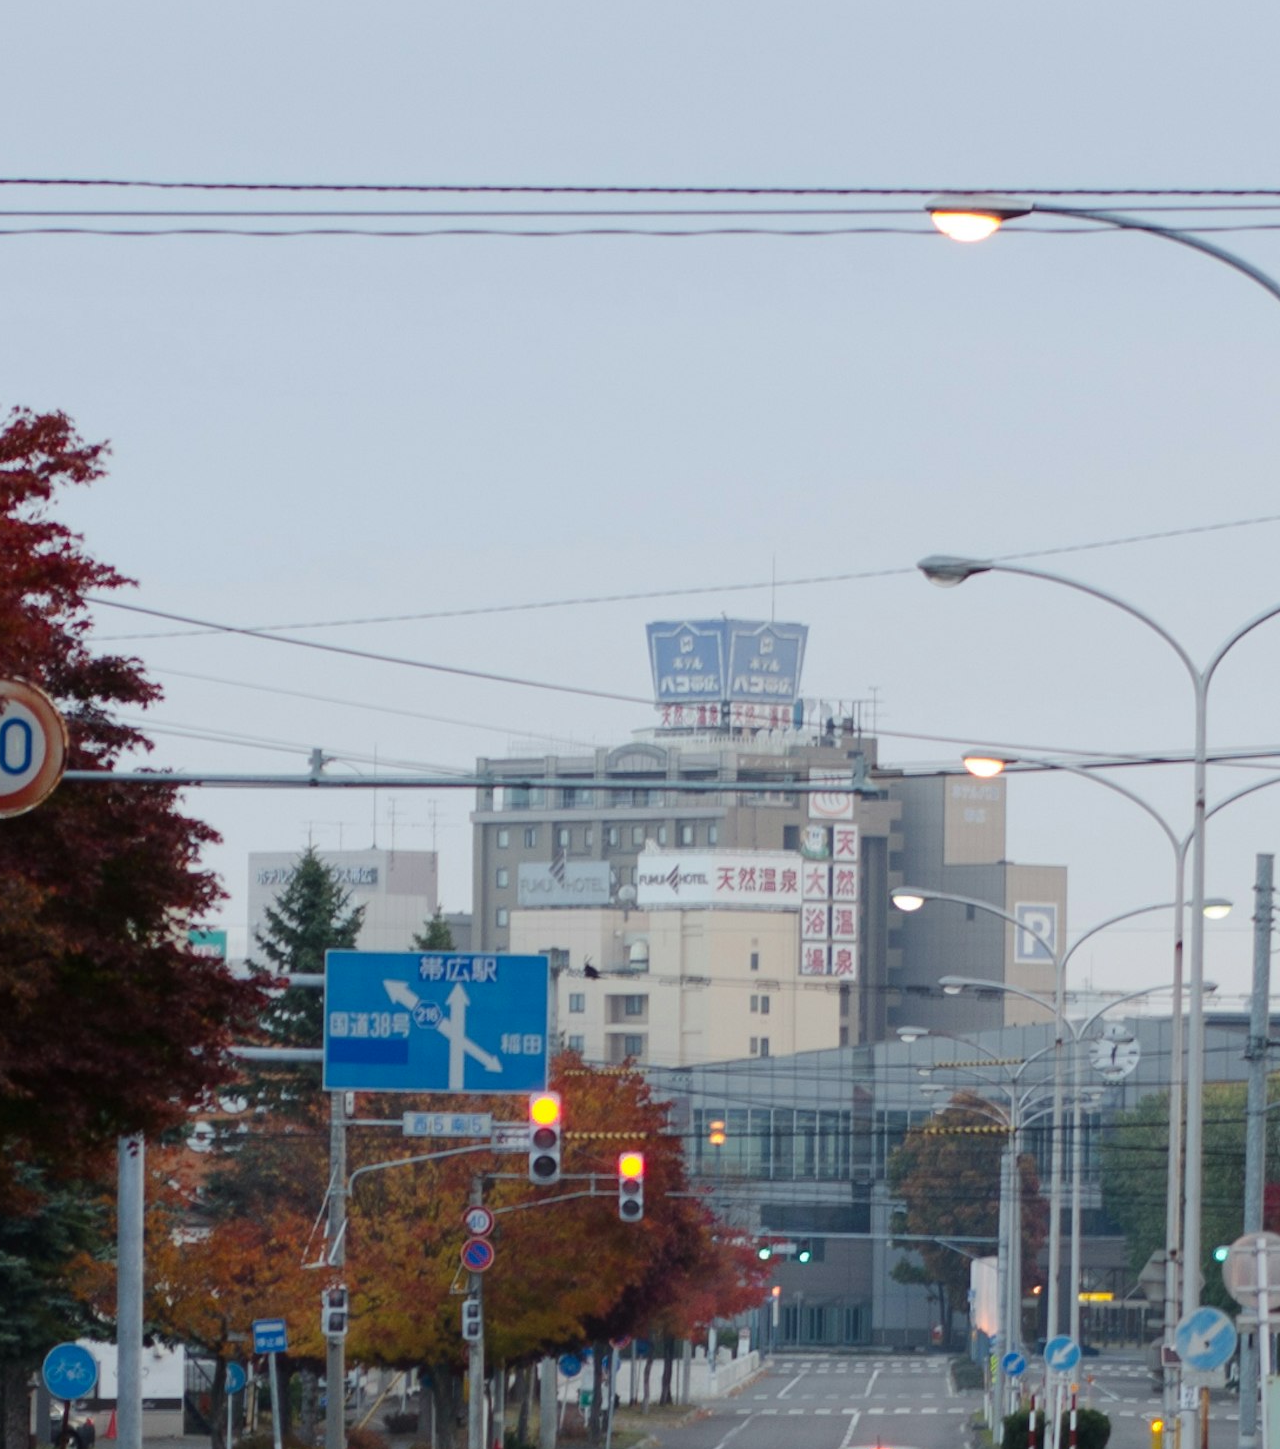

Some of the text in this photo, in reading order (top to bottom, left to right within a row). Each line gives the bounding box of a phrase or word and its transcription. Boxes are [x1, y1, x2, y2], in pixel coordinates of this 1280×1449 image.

[679, 873, 709, 886] HOTEL
[716, 866, 798, 894] 天然温泉
[1023, 912, 1051, 955] P
[420, 956, 498, 983] 帯広駅
[329, 1011, 411, 1038] 国道38号
[500, 1033, 542, 1055] 稲田
